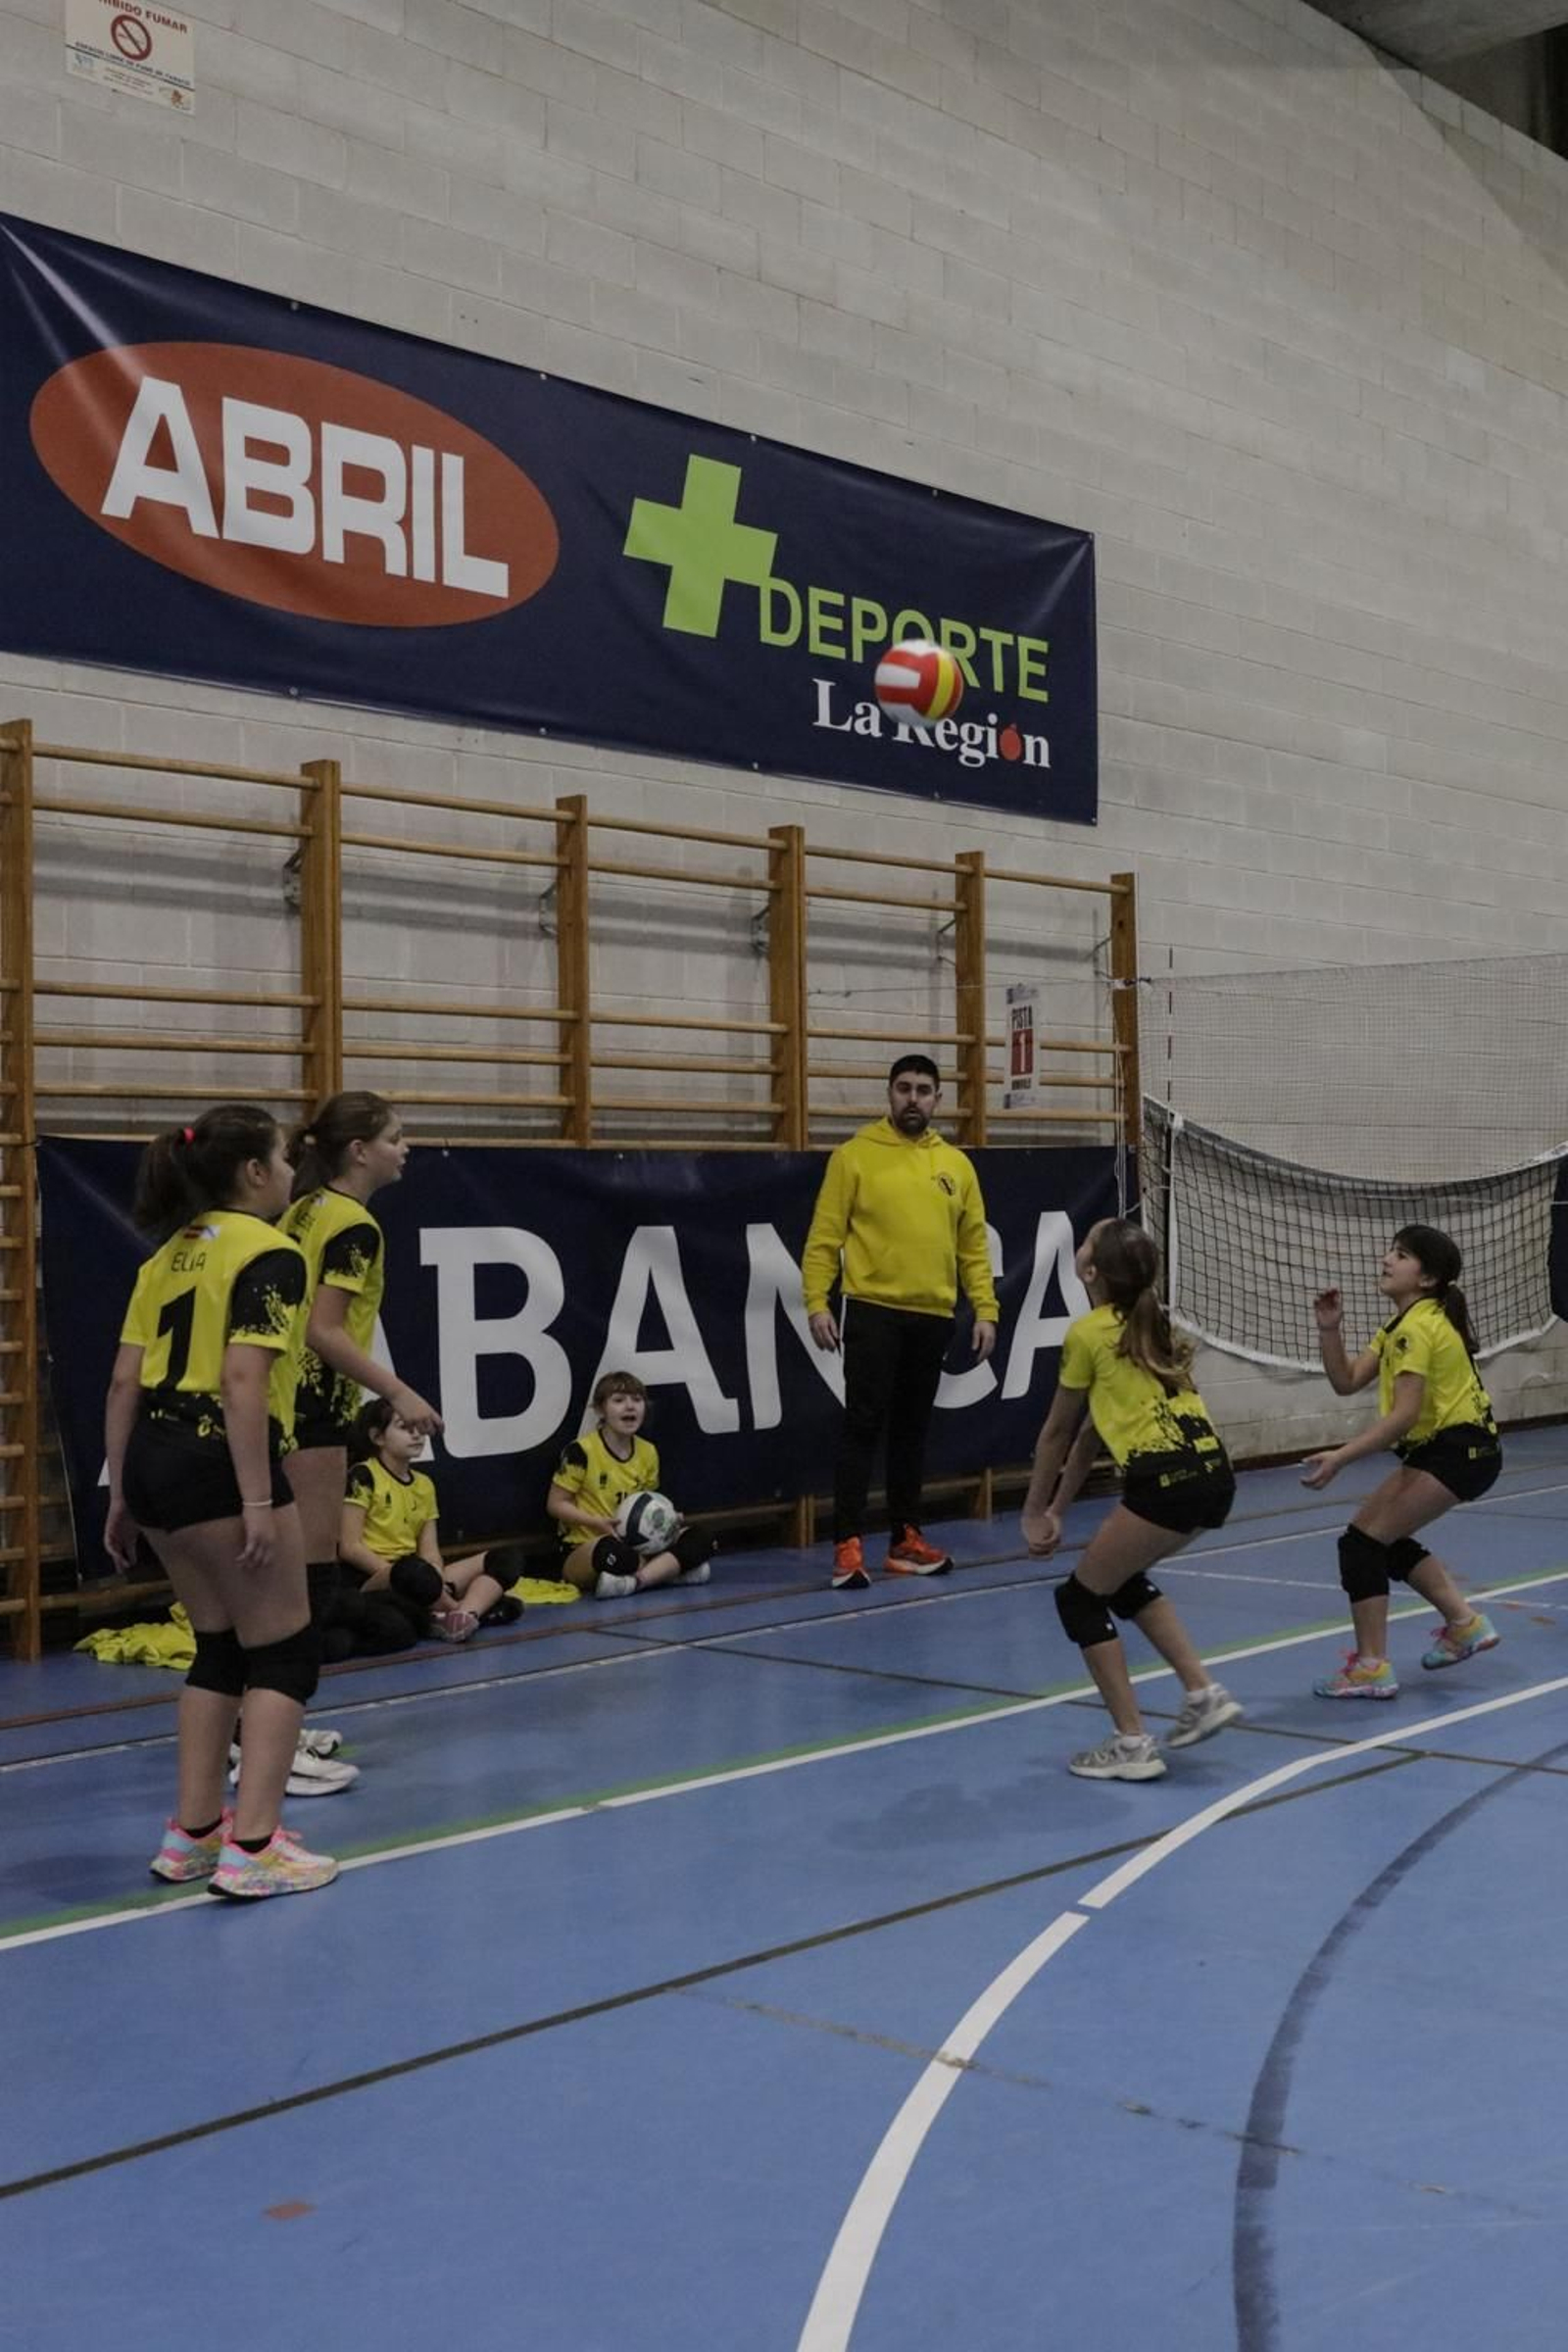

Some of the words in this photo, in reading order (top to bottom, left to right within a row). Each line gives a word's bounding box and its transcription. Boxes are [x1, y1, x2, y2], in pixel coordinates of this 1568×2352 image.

[146, 11, 187, 33] FUMAR
[101, 375, 510, 599] ABRIL
[811, 678, 883, 738] La
[98, 1210, 1092, 1487] BANA
[158, 1285, 197, 1390] 1
